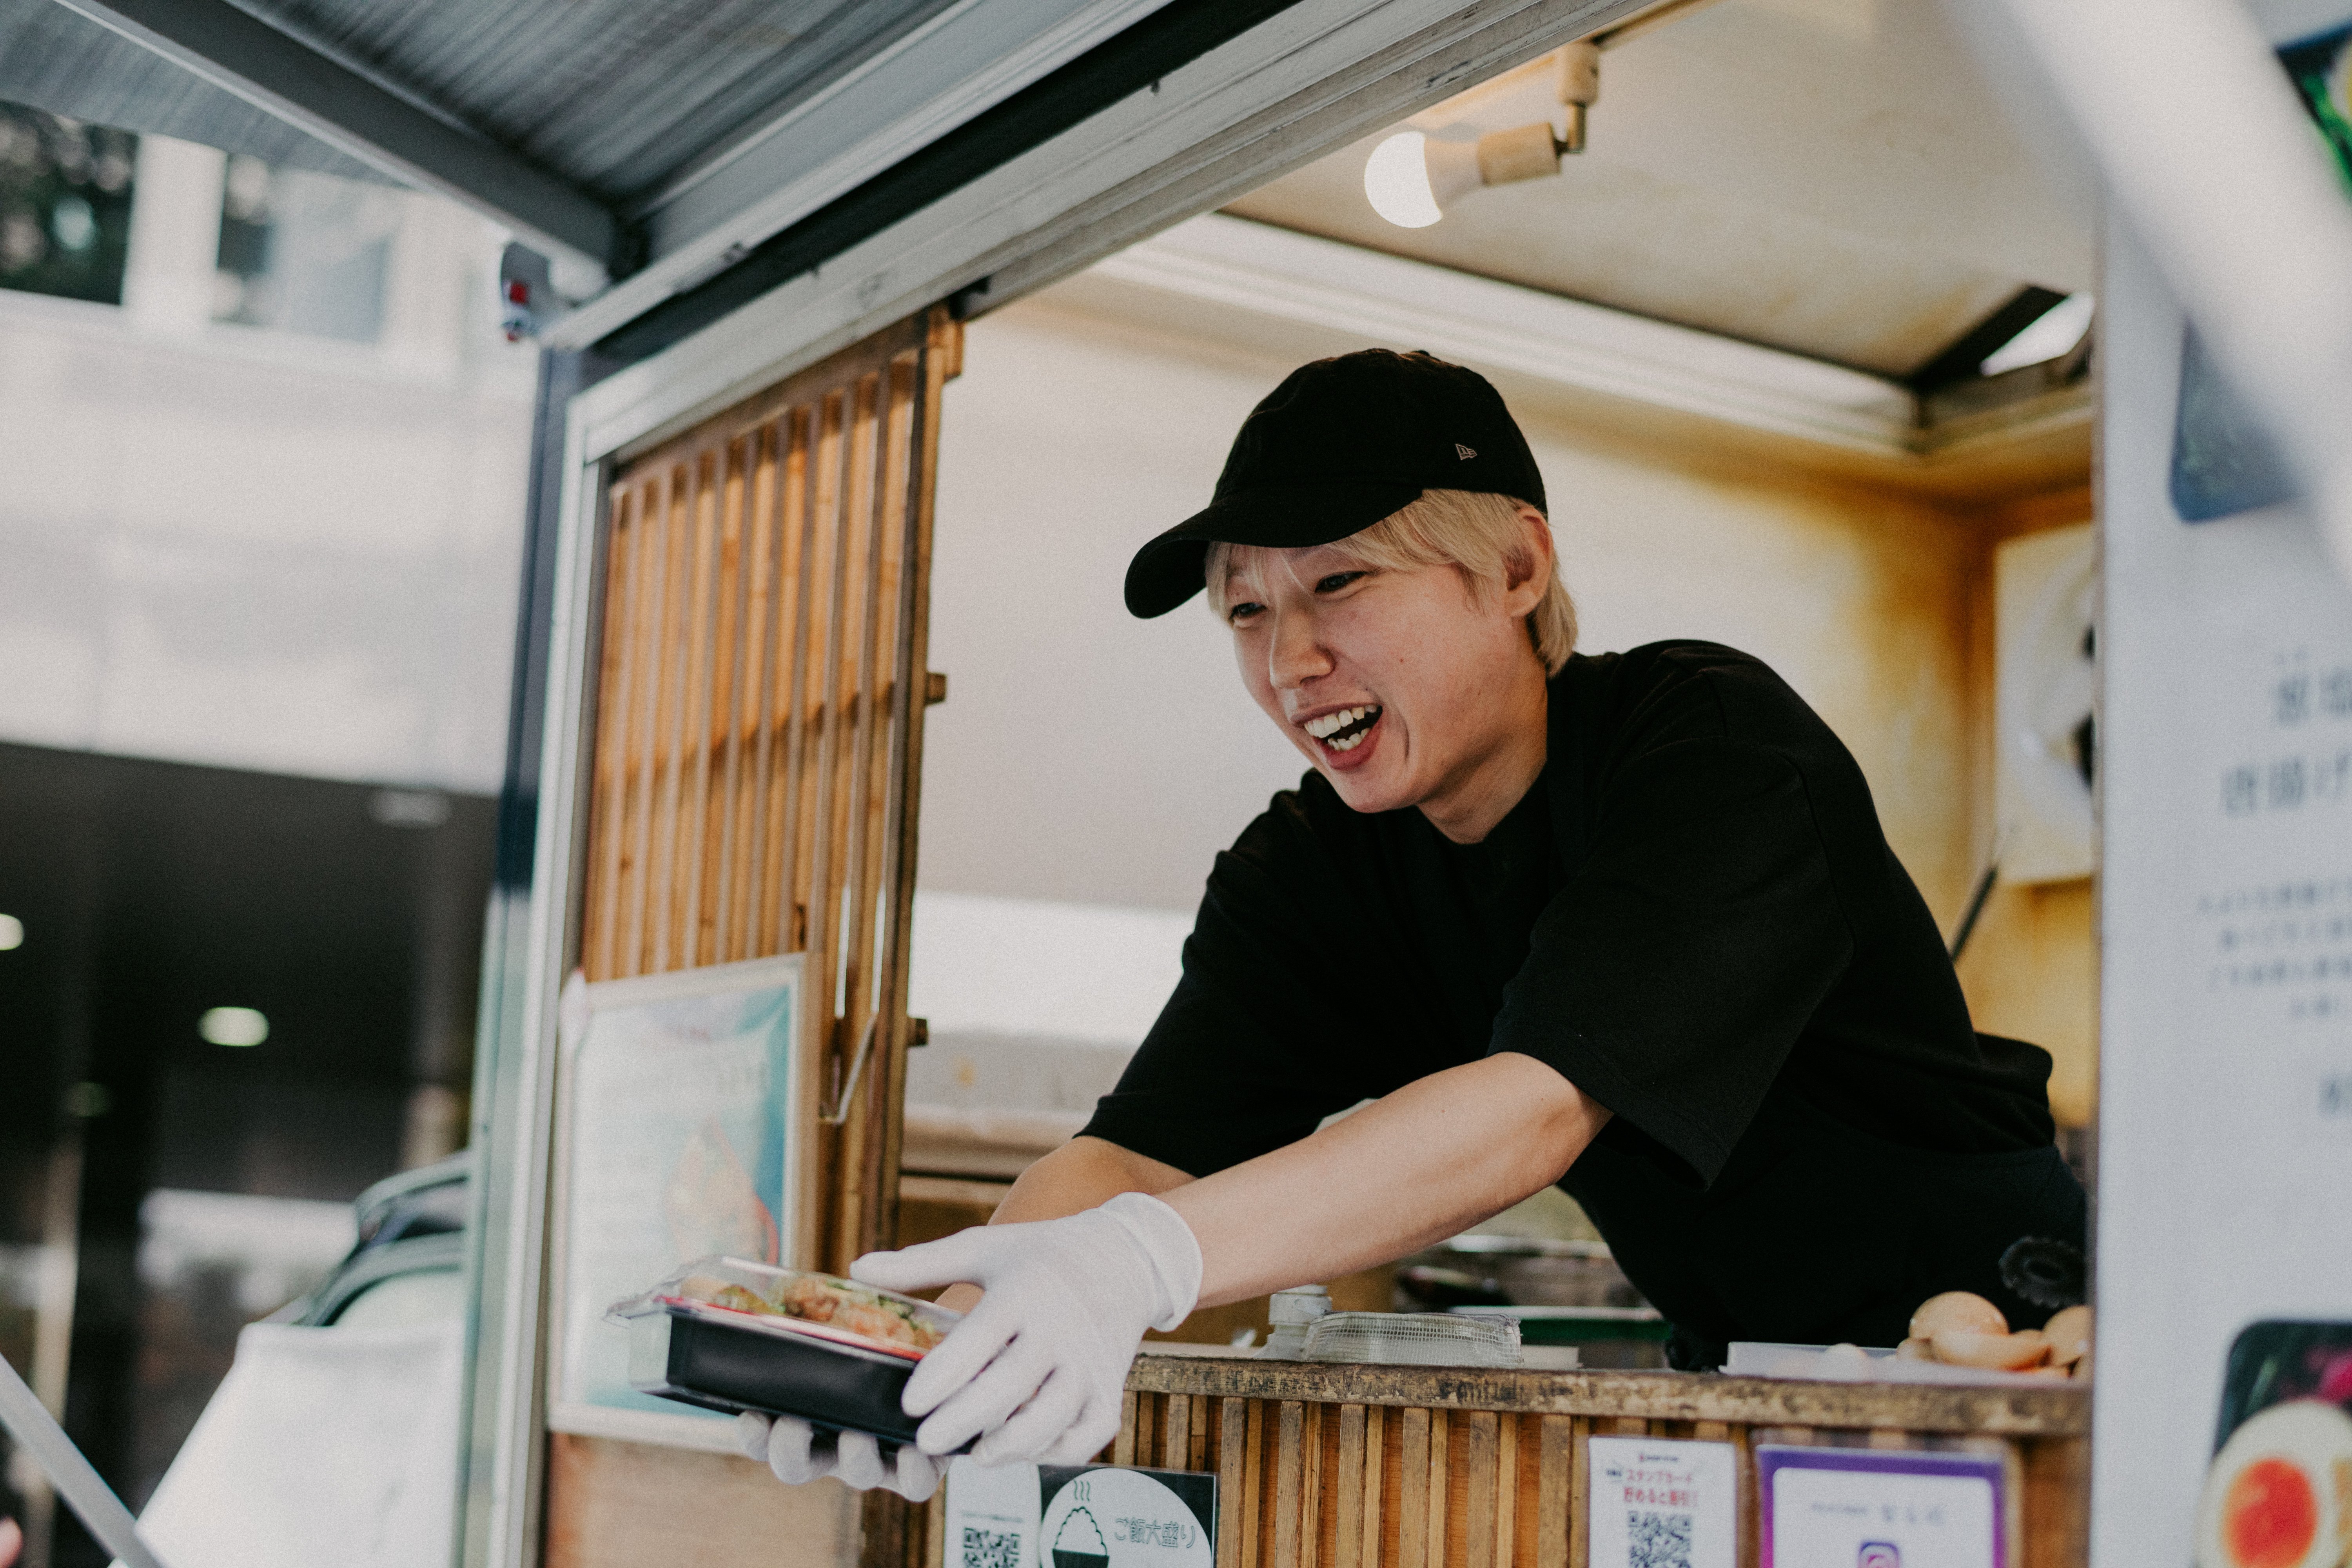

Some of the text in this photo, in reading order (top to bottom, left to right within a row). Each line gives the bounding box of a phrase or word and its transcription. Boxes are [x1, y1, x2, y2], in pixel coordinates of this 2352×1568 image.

[1114, 1517, 1196, 1548] ご飯大盛り
